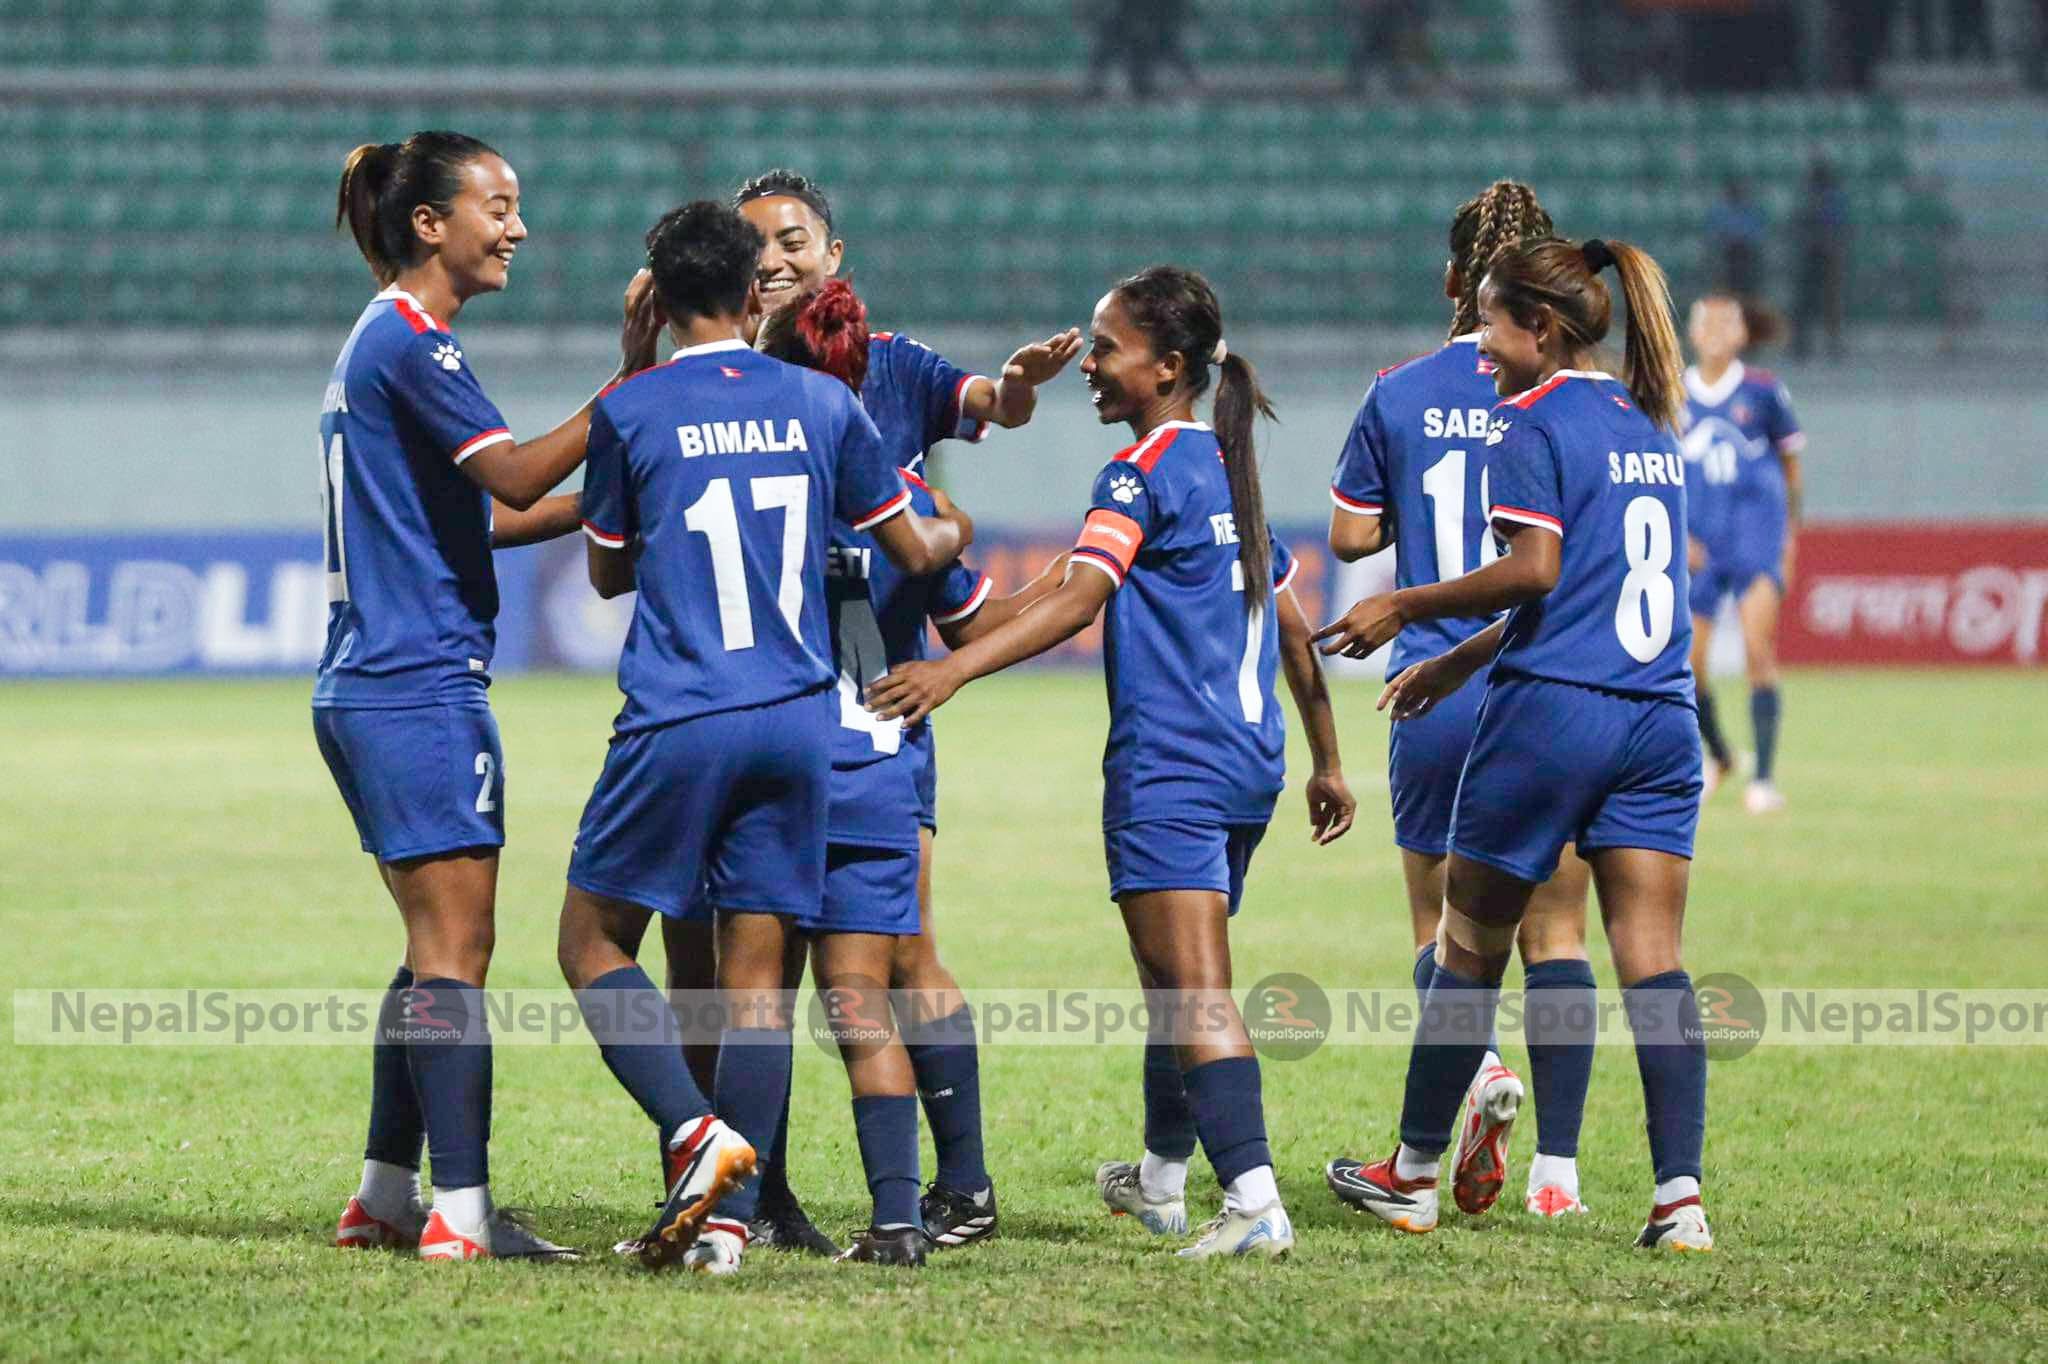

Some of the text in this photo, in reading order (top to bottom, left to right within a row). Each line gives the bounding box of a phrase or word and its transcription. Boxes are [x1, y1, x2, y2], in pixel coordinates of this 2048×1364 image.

[676, 419, 808, 458] BIMALA
[1423, 407, 1490, 438] SAB
[1608, 451, 1684, 486] SARU
[684, 475, 809, 651] 17
[1615, 496, 1674, 664] 8
[474, 752, 497, 813] 2
